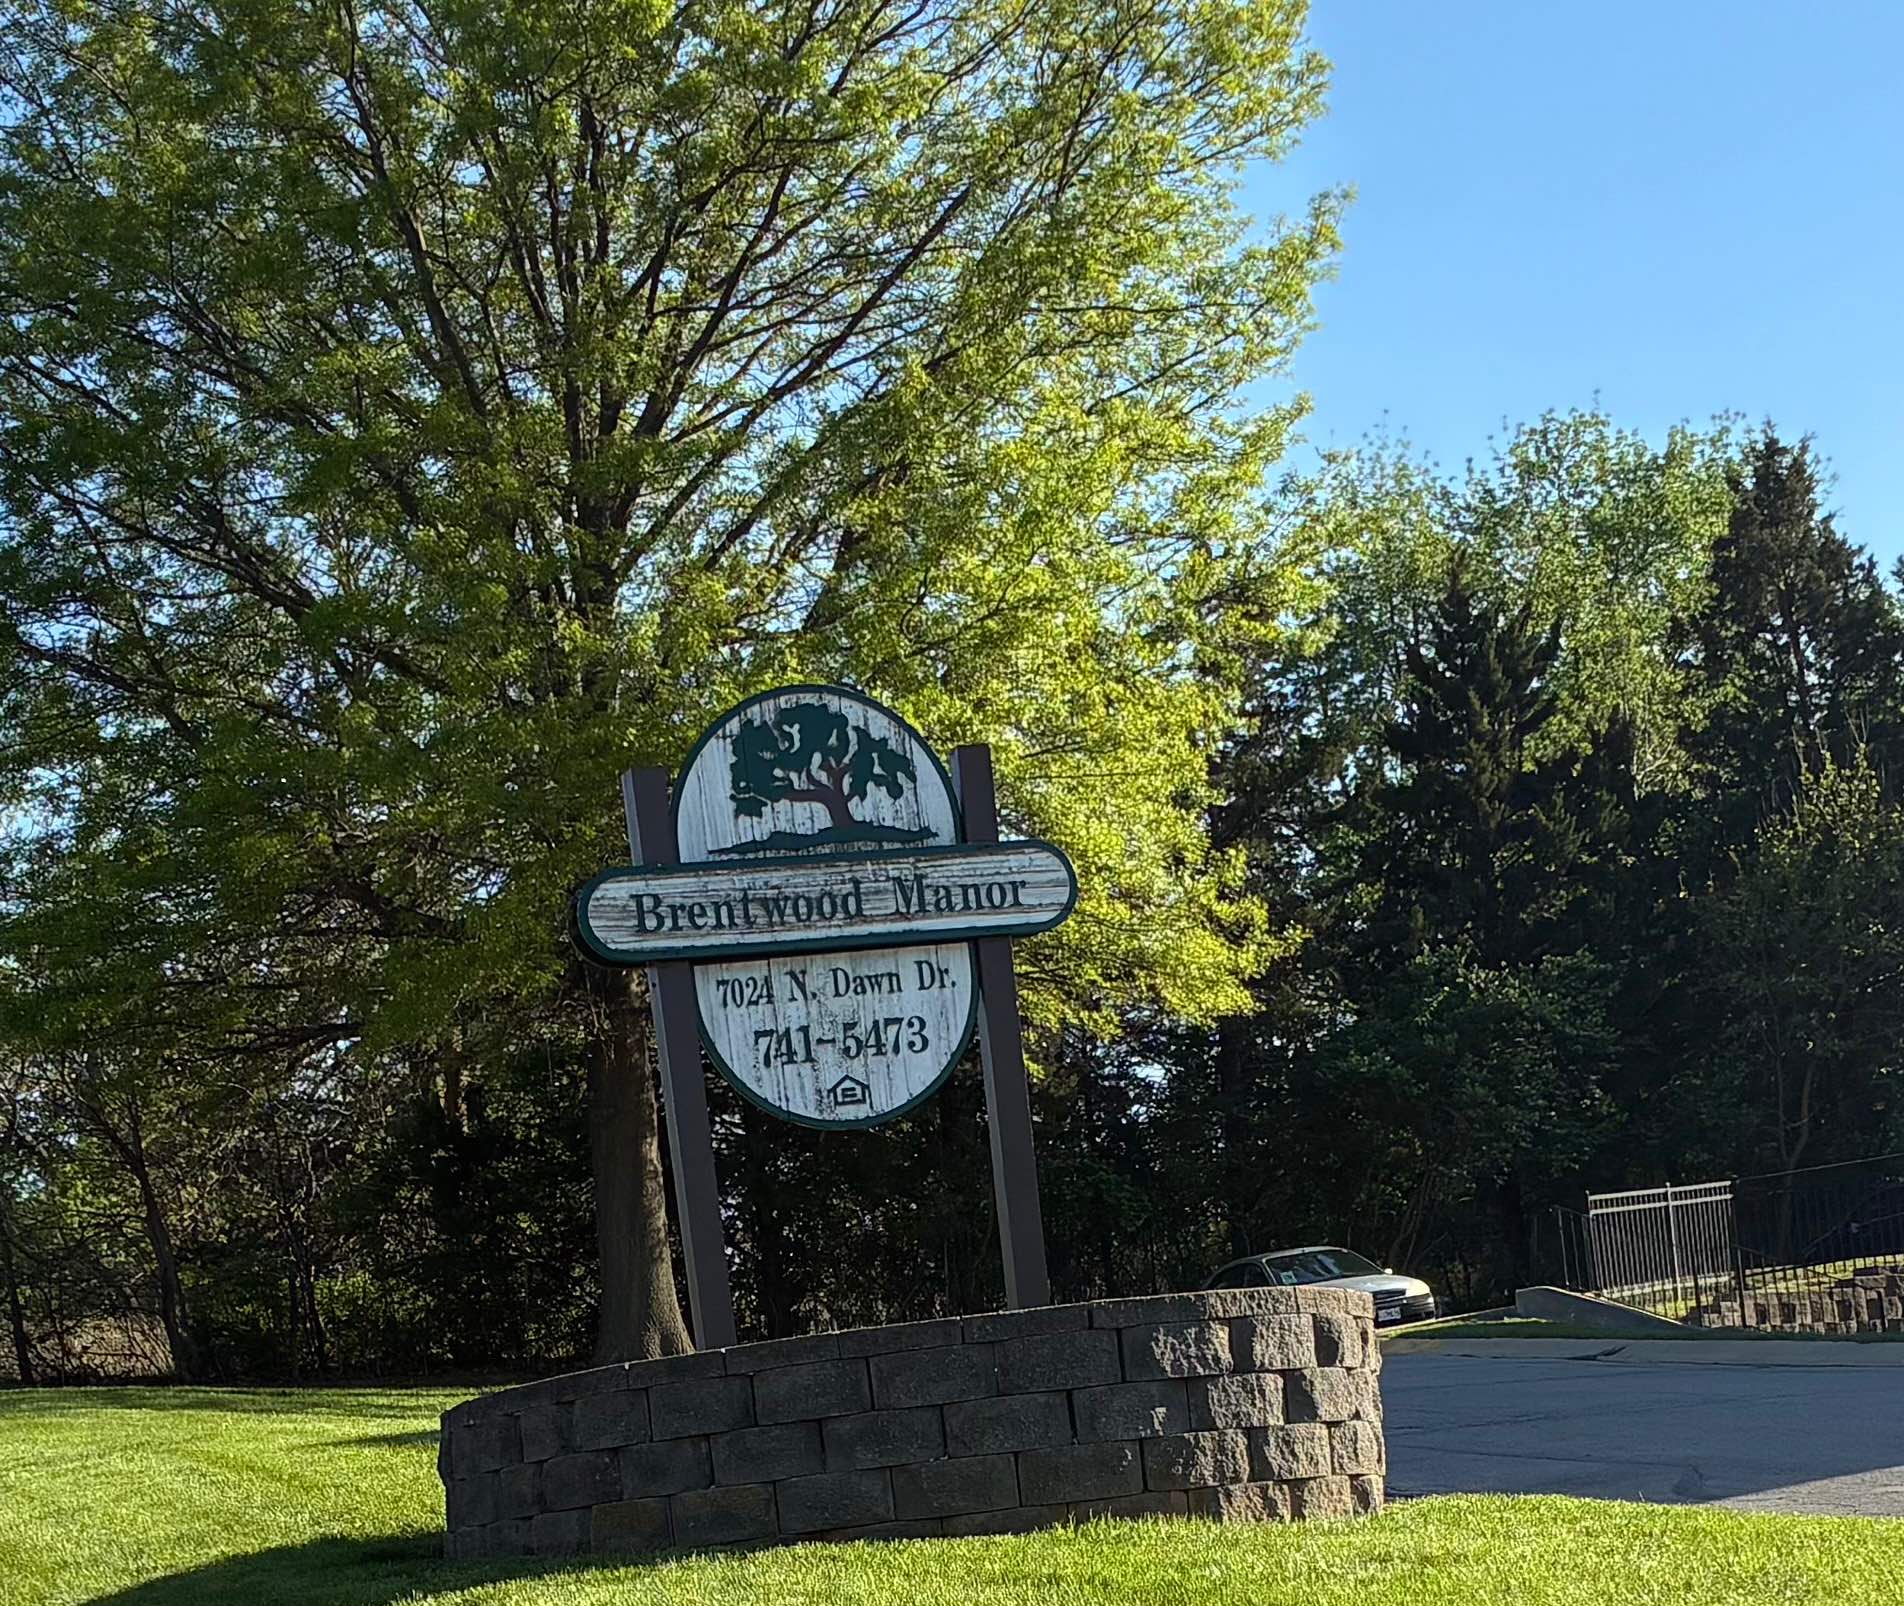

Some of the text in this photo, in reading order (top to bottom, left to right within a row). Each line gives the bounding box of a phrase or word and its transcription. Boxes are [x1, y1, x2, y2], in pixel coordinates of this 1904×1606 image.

[630, 873, 1026, 934] Brentwood Manor
[716, 960, 957, 1008] 7024 N. Dawn Dr.
[753, 1015, 929, 1068] 741-5473
